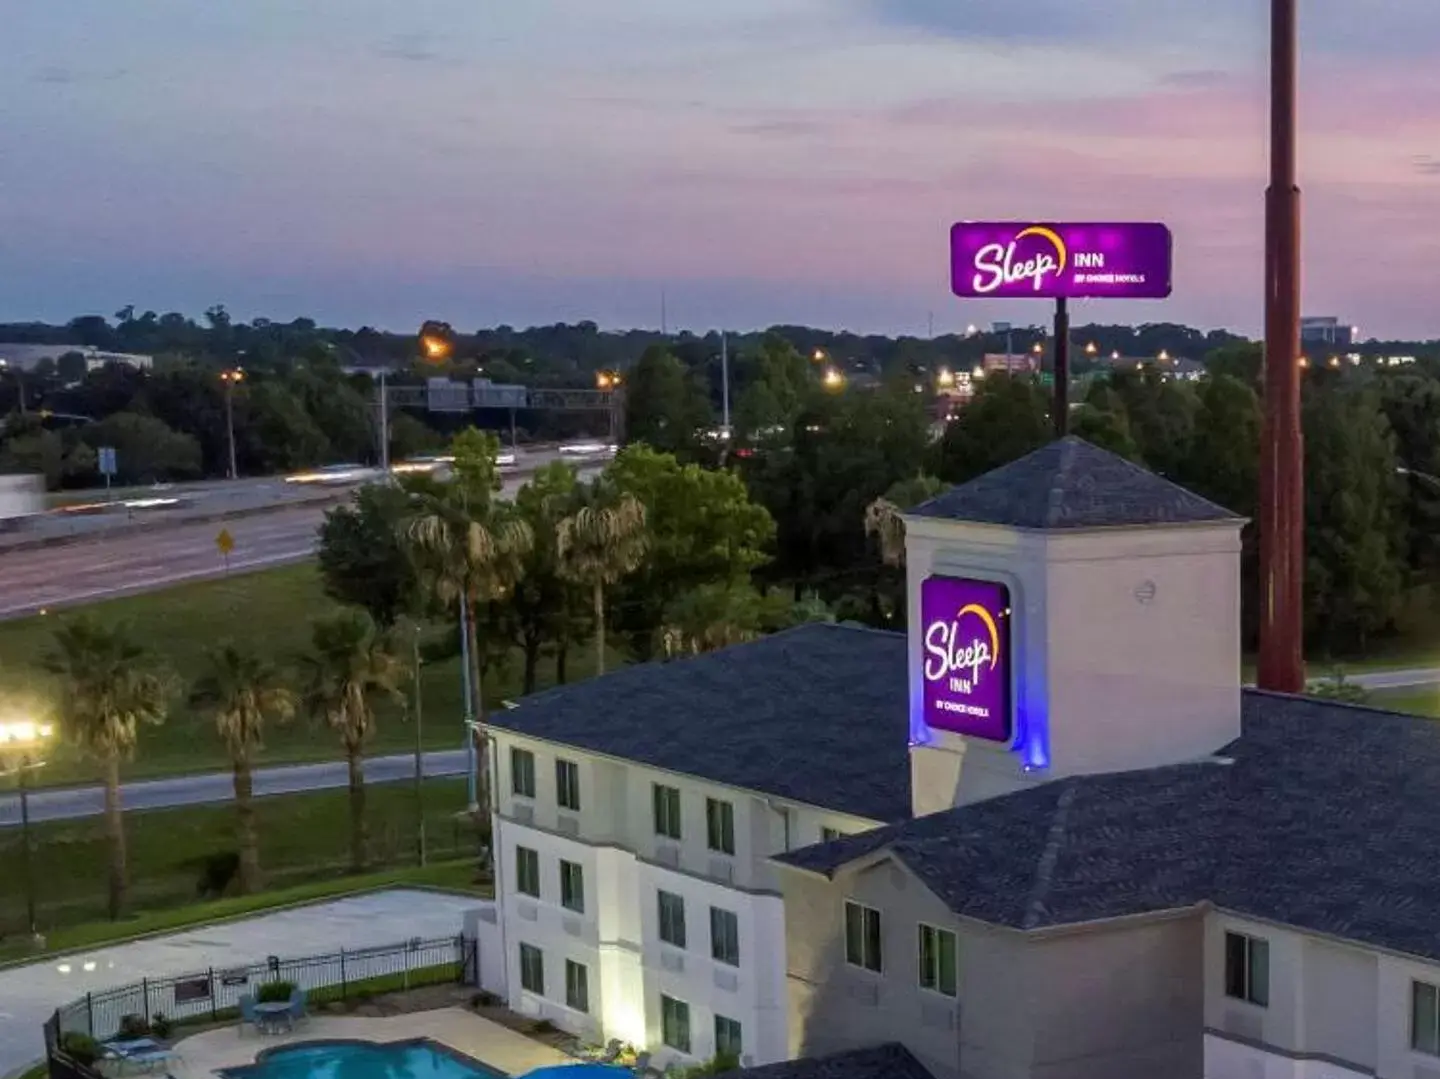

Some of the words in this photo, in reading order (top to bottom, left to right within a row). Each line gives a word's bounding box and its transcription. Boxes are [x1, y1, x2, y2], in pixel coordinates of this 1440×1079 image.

[973, 241, 1057, 292] Sleep
[1074, 252, 1104, 267] INN
[925, 620, 991, 685] Sleep
[949, 677, 972, 695] INN
